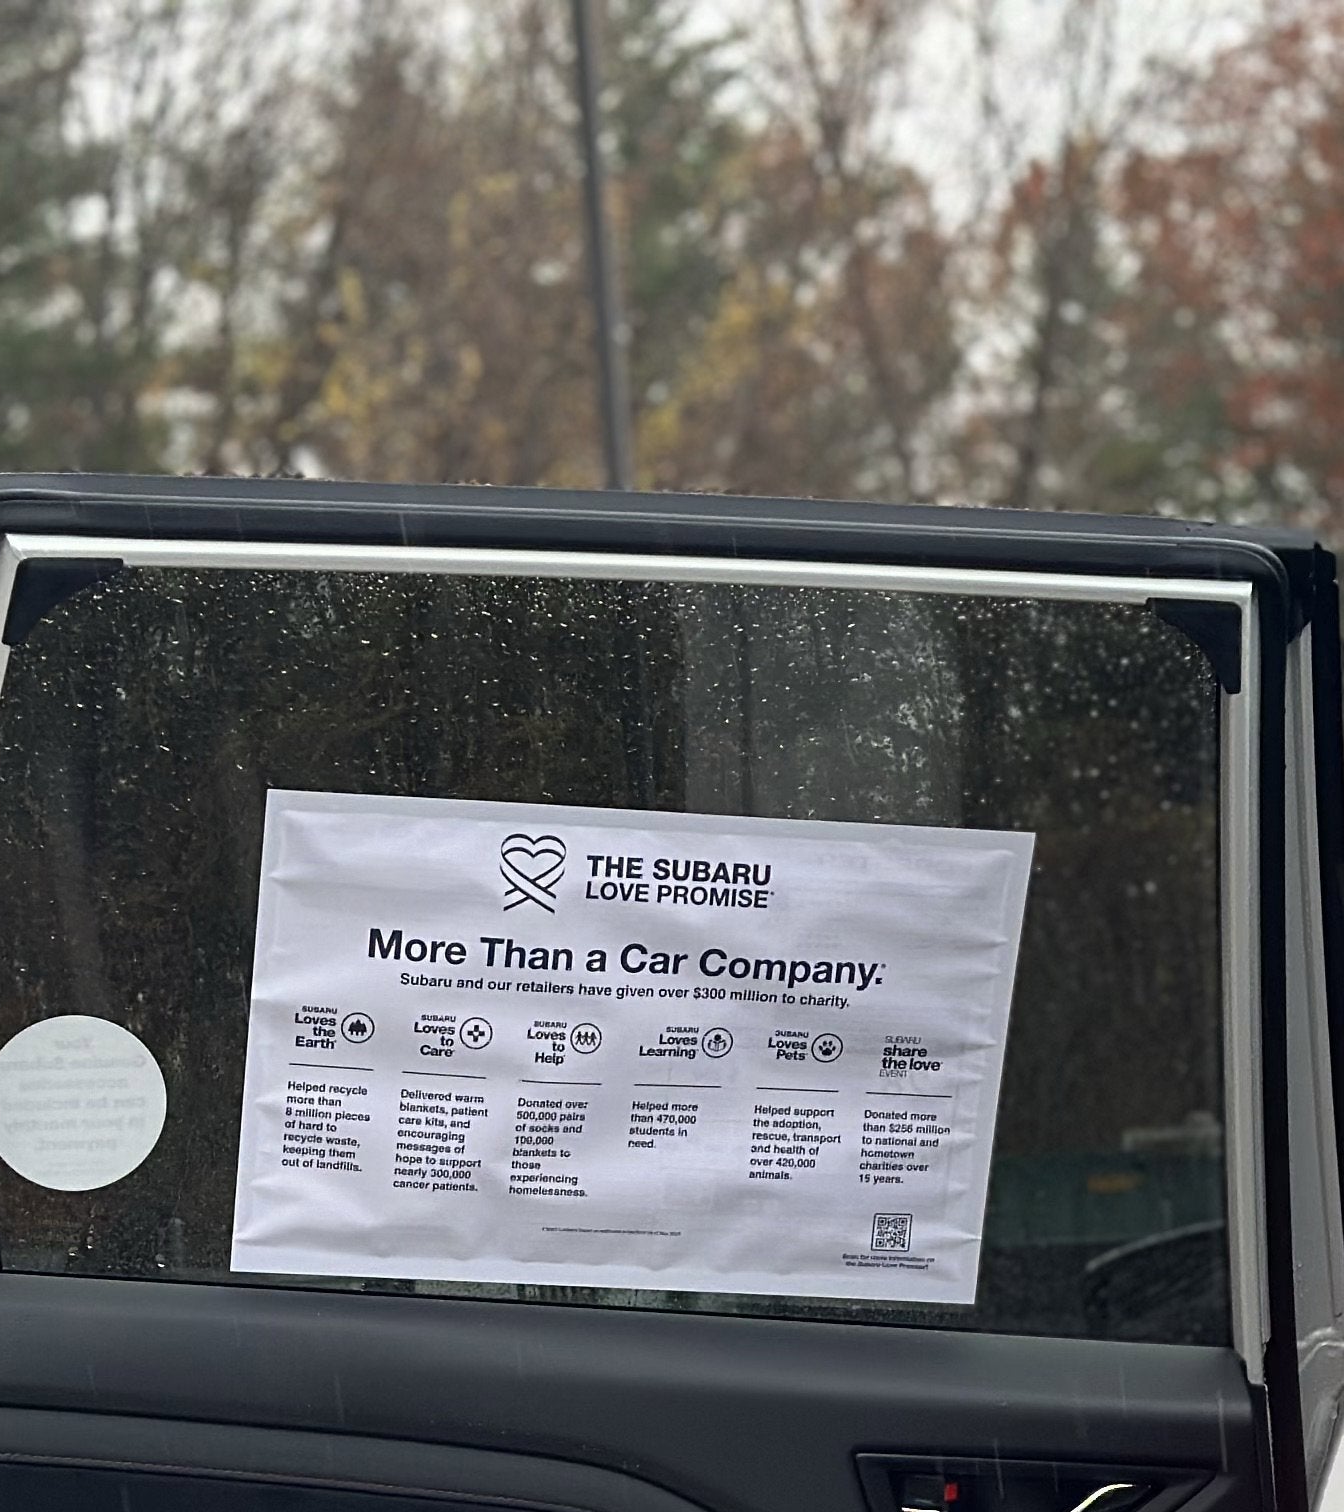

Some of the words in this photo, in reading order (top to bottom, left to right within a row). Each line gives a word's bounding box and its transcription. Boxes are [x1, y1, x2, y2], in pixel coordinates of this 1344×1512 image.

[586, 855, 643, 879] THE
[653, 859, 772, 885] SUBARU
[586, 881, 650, 903] LOVE
[656, 885, 768, 909] PROMISE
[368, 928, 467, 965] More
[481, 937, 573, 973] Than
[586, 949, 607, 973] a
[620, 943, 688, 976] Car
[400, 973, 452, 988] Subaru
[457, 978, 484, 991] and
[488, 979, 512, 992] our
[516, 979, 574, 997] retailers
[578, 983, 612, 997] have
[617, 986, 654, 1000] given
[658, 987, 689, 998] over
[694, 986, 726, 1001] $300
[730, 989, 777, 1003] million
[781, 991, 796, 1004] to
[799, 993, 850, 1009] charity.
[302, 1006, 337, 1014] SUBARU
[295, 1013, 336, 1026] Loves
[313, 1025, 335, 1037] the
[414, 1022, 455, 1035] Loves
[527, 1029, 566, 1041] Loves
[659, 1034, 697, 1045] Loves
[296, 1036, 334, 1049] Earth
[440, 1036, 454, 1047] to
[553, 1042, 565, 1052] to
[768, 1037, 807, 1049] Loves
[420, 1045, 453, 1057] Care
[639, 1046, 696, 1059] Learning
[776, 1050, 805, 1060] Pets
[883, 1045, 927, 1057] share
[535, 1053, 564, 1065] Help
[882, 1057, 906, 1069] the
[909, 1058, 940, 1071] love
[288, 1081, 325, 1094] Helped
[329, 1086, 367, 1096] recycle
[287, 1096, 314, 1105] more
[318, 1096, 341, 1106] than
[401, 1090, 451, 1101] Delivered
[455, 1095, 484, 1103] warm
[518, 1098, 562, 1108] Donated
[566, 1101, 588, 1109] over
[632, 1101, 668, 1112] Helped
[286, 1108, 292, 1116] 8
[295, 1109, 331, 1119] million
[335, 1111, 370, 1122] pieces
[451, 1106, 488, 1117] patient
[517, 1111, 556, 1122] 500,000
[560, 1112, 585, 1122] pairs
[755, 1105, 790, 1116] Helped
[794, 1107, 834, 1119] support
[864, 1110, 906, 1120] Donated
[911, 1113, 936, 1121] more
[398, 1117, 421, 1125] care
[425, 1117, 447, 1128] kits,
[450, 1119, 470, 1128] and
[631, 1114, 653, 1123] than
[657, 1115, 696, 1125] 470,000
[753, 1119, 770, 1128] the
[773, 1120, 821, 1131] adoption,
[285, 1120, 296, 1129] of
[299, 1121, 323, 1131] hard
[326, 1123, 337, 1132] to
[516, 1124, 526, 1132] of
[529, 1124, 559, 1133] socks
[563, 1125, 582, 1133] and
[629, 1127, 675, 1136] students
[678, 1128, 687, 1136] in
[863, 1124, 886, 1133] than
[916, 1125, 950, 1134] million
[284, 1133, 322, 1144] recycle
[326, 1137, 360, 1148] waste,
[397, 1130, 465, 1142] encouraging
[752, 1133, 790, 1142] rescue,
[793, 1134, 841, 1144] transport
[862, 1137, 872, 1145] to
[875, 1137, 916, 1146] national
[919, 1137, 939, 1147] and
[397, 1142, 451, 1154] messages
[454, 1145, 465, 1154] of
[628, 1139, 656, 1148] need.
[283, 1145, 325, 1158] keeping
[329, 1148, 355, 1158] them
[513, 1148, 556, 1157] blankets
[560, 1149, 571, 1157] to
[751, 1145, 770, 1153] and
[774, 1146, 805, 1155] health
[809, 1146, 819, 1155] of
[861, 1148, 914, 1158] hometown
[282, 1158, 299, 1167] out
[303, 1159, 313, 1168] of
[317, 1160, 362, 1171] landfills.
[396, 1153, 422, 1165] hope
[426, 1156, 436, 1165] to
[439, 1158, 481, 1168] support
[511, 1161, 541, 1170] those
[750, 1158, 773, 1166] over
[860, 1161, 903, 1171] charities
[907, 1163, 929, 1172] over
[394, 1167, 427, 1178] nearly
[430, 1169, 471, 1180] 300,000
[510, 1173, 578, 1185] experiencing
[749, 1170, 792, 1180] animals.
[859, 1174, 870, 1183] 15
[873, 1175, 903, 1185] years.
[393, 1180, 430, 1189] cancer
[432, 1182, 478, 1192] patients.
[509, 1186, 587, 1196] homelessness.
